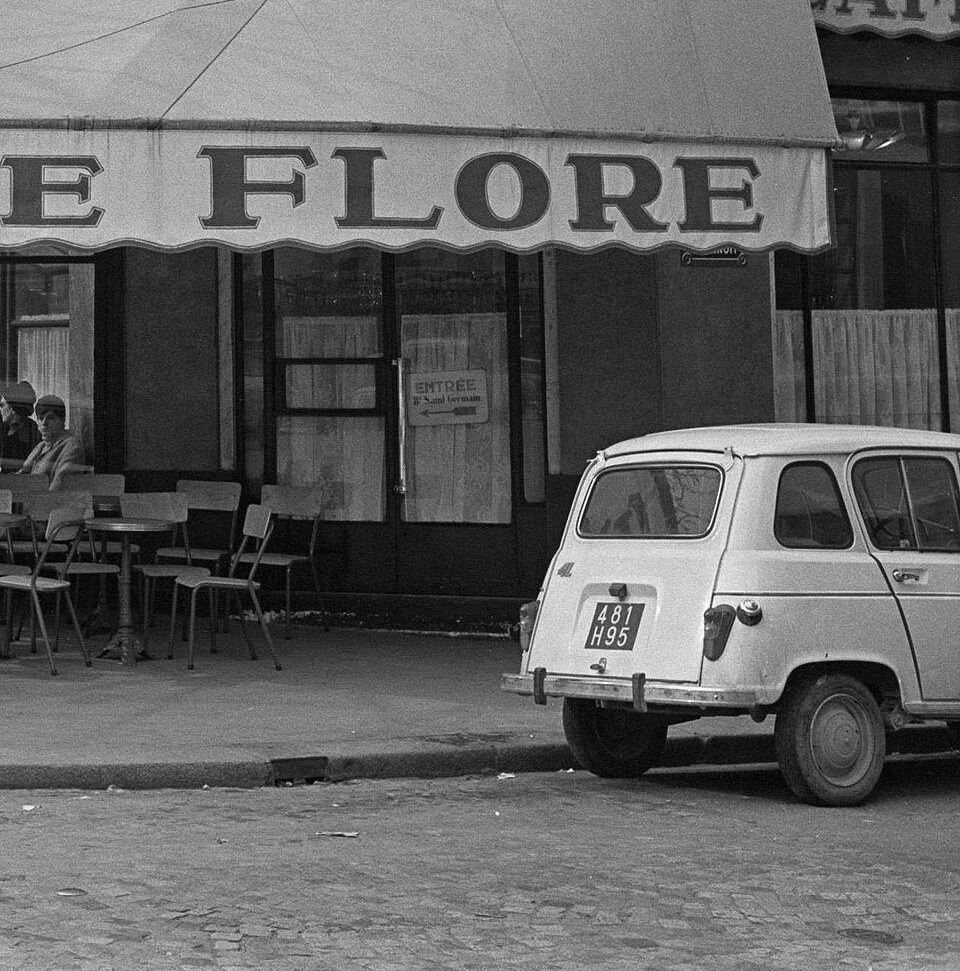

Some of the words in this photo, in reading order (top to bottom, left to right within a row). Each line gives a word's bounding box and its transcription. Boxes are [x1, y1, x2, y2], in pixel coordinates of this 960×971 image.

[197, 144, 765, 234] FLORE
[597, 604, 634, 625] 481
[590, 625, 630, 647] H95
